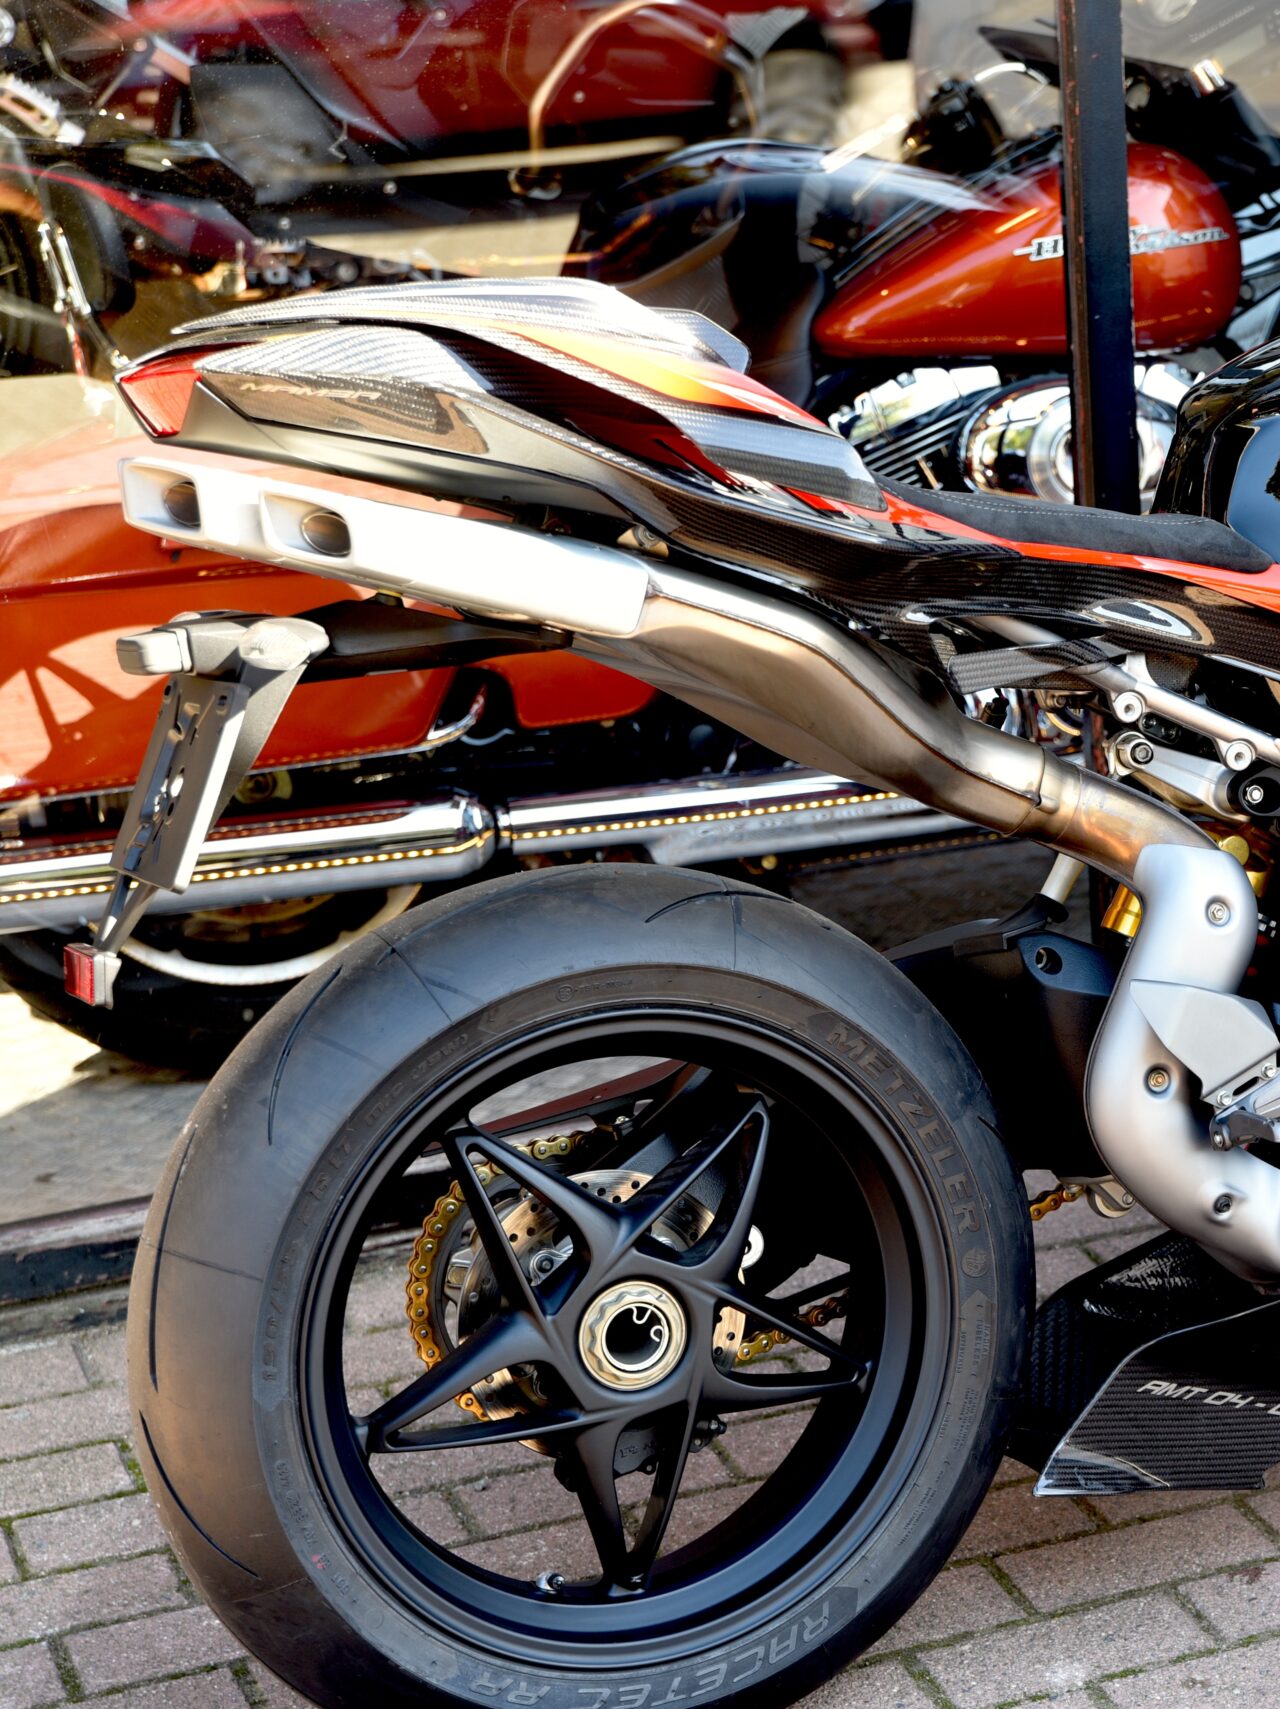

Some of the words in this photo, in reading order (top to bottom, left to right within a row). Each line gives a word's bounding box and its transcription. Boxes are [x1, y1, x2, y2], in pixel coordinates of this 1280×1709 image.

[825, 1021, 981, 1235] METZELER
[1136, 1380, 1209, 1400] AMT
[1202, 1391, 1255, 1409] 04
[468, 1670, 552, 1707] RR
[576, 1601, 830, 1709] RACETEC
